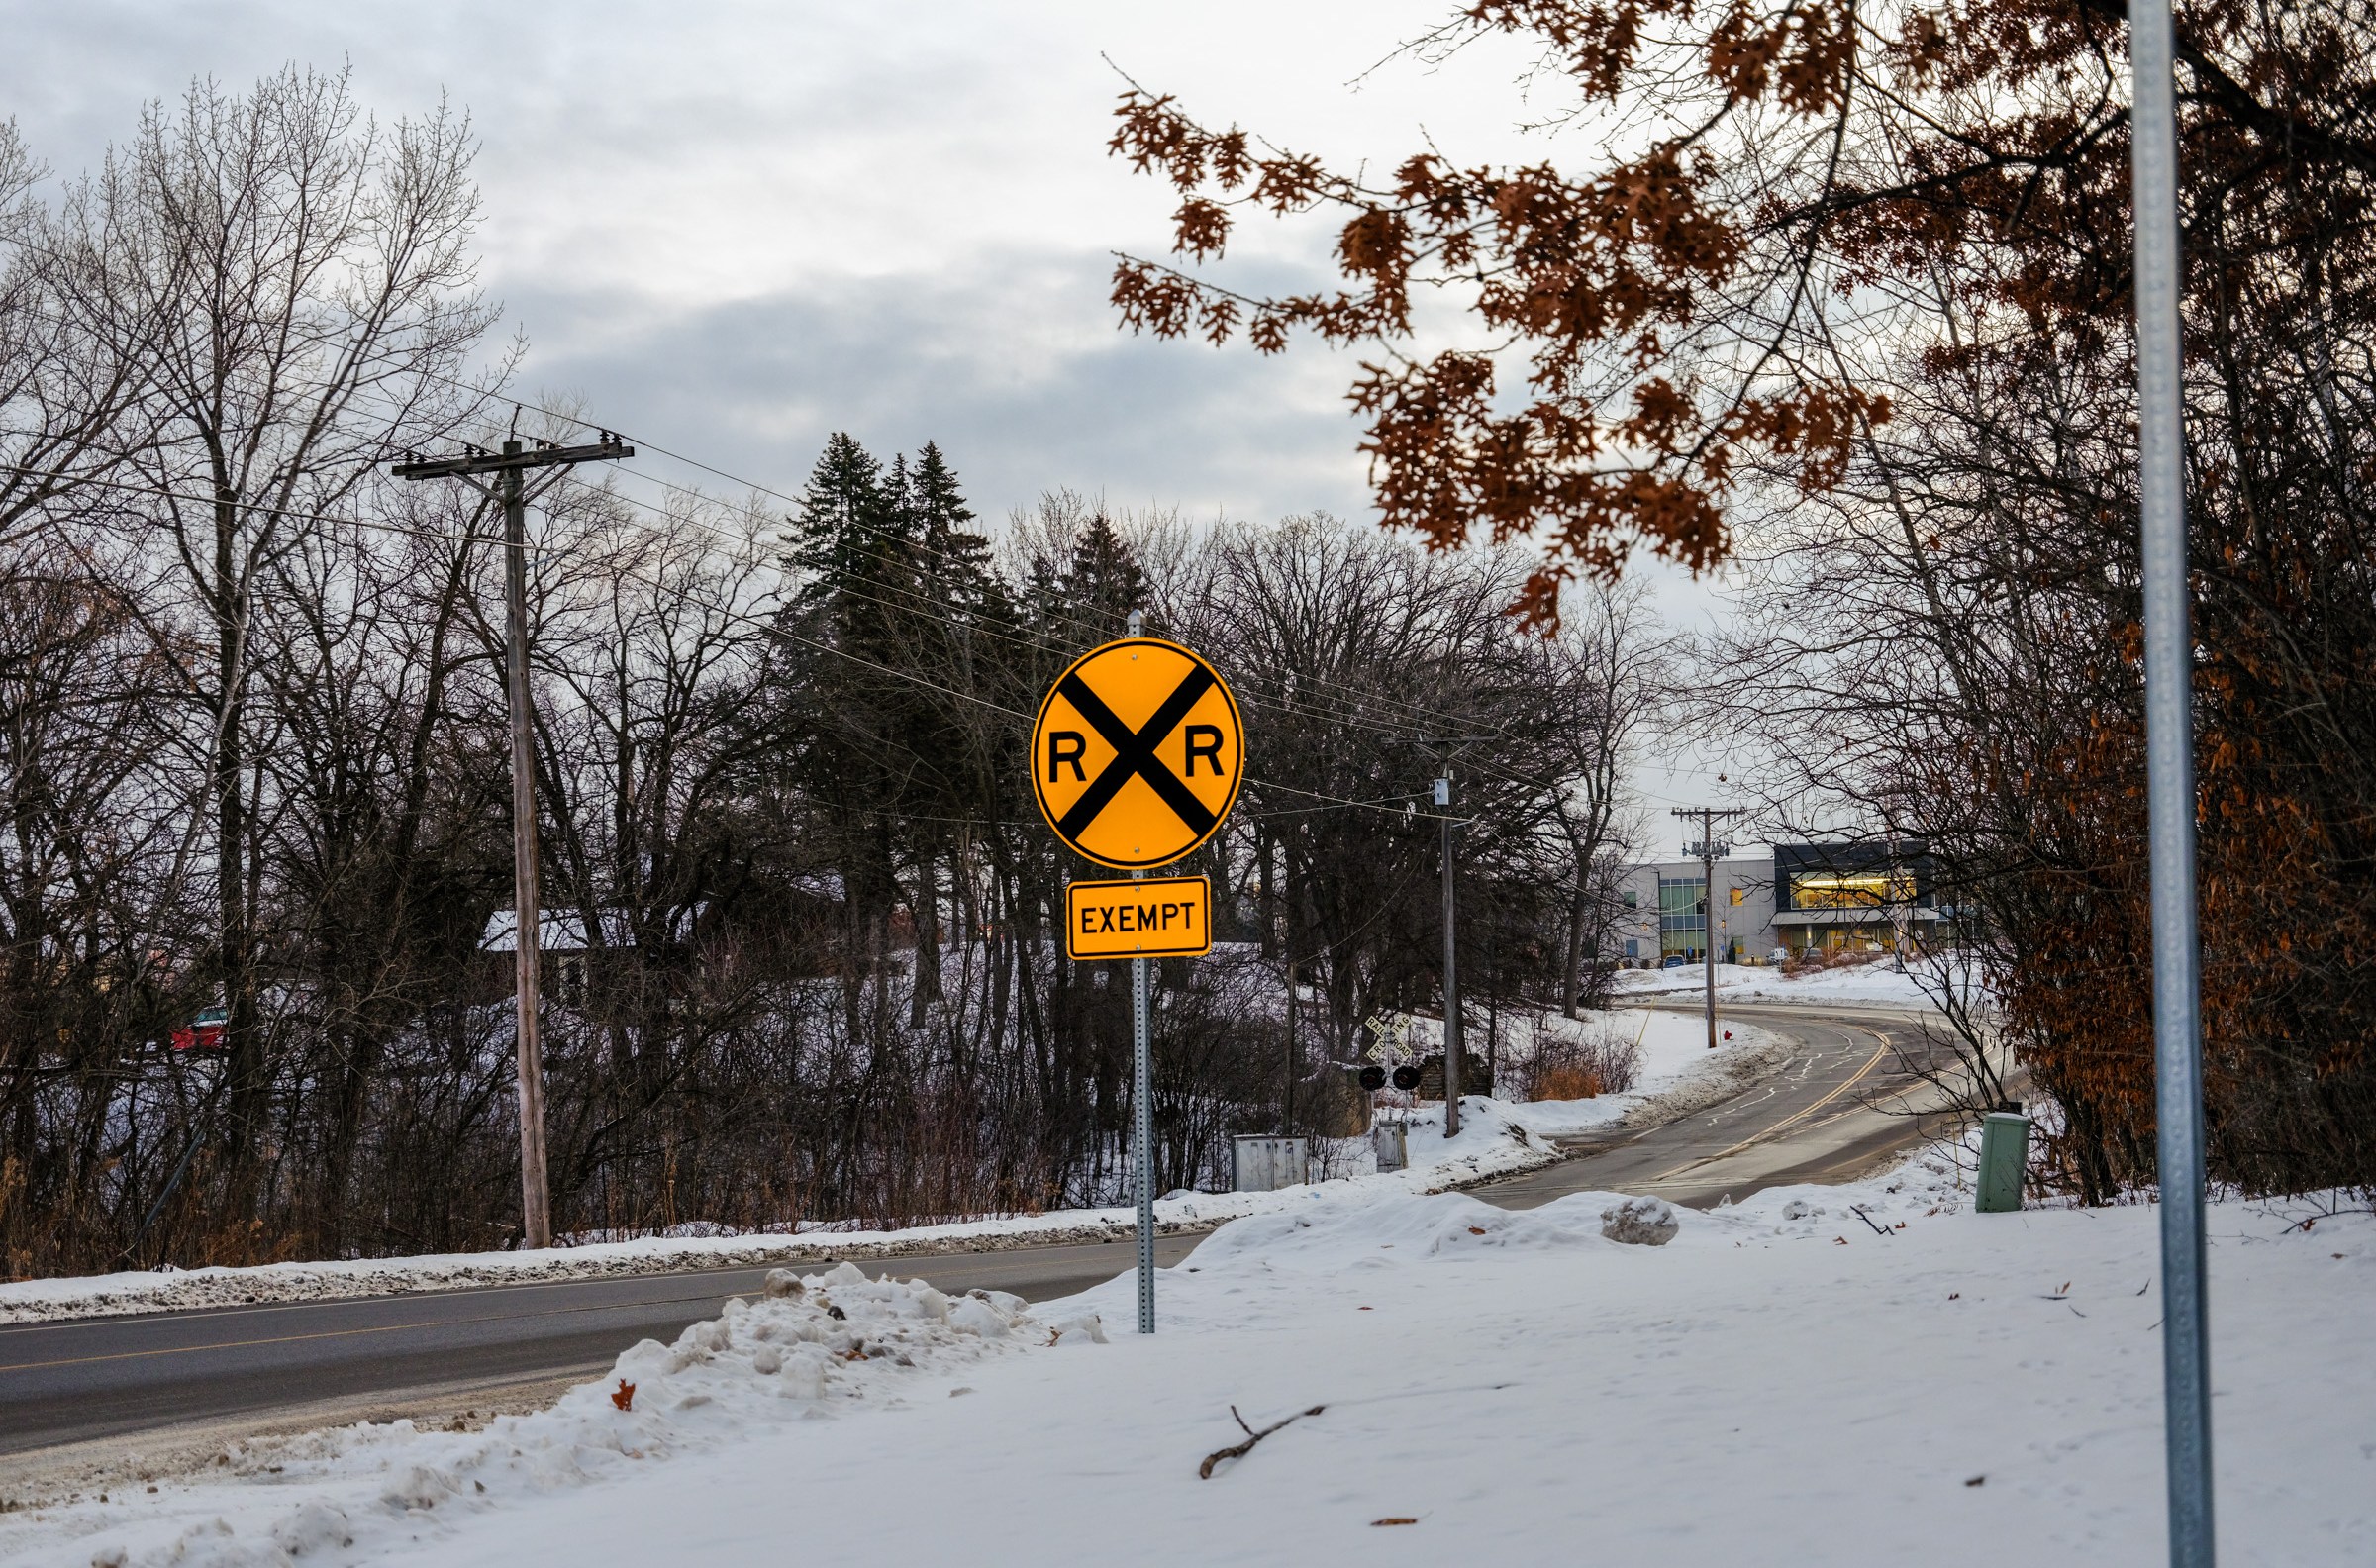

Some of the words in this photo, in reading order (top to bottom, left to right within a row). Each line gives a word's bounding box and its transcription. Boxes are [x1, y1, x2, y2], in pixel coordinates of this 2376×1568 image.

[1049, 731, 1087, 783] R
[1185, 724, 1225, 777] R
[1081, 902, 1195, 934] EXEMPT
